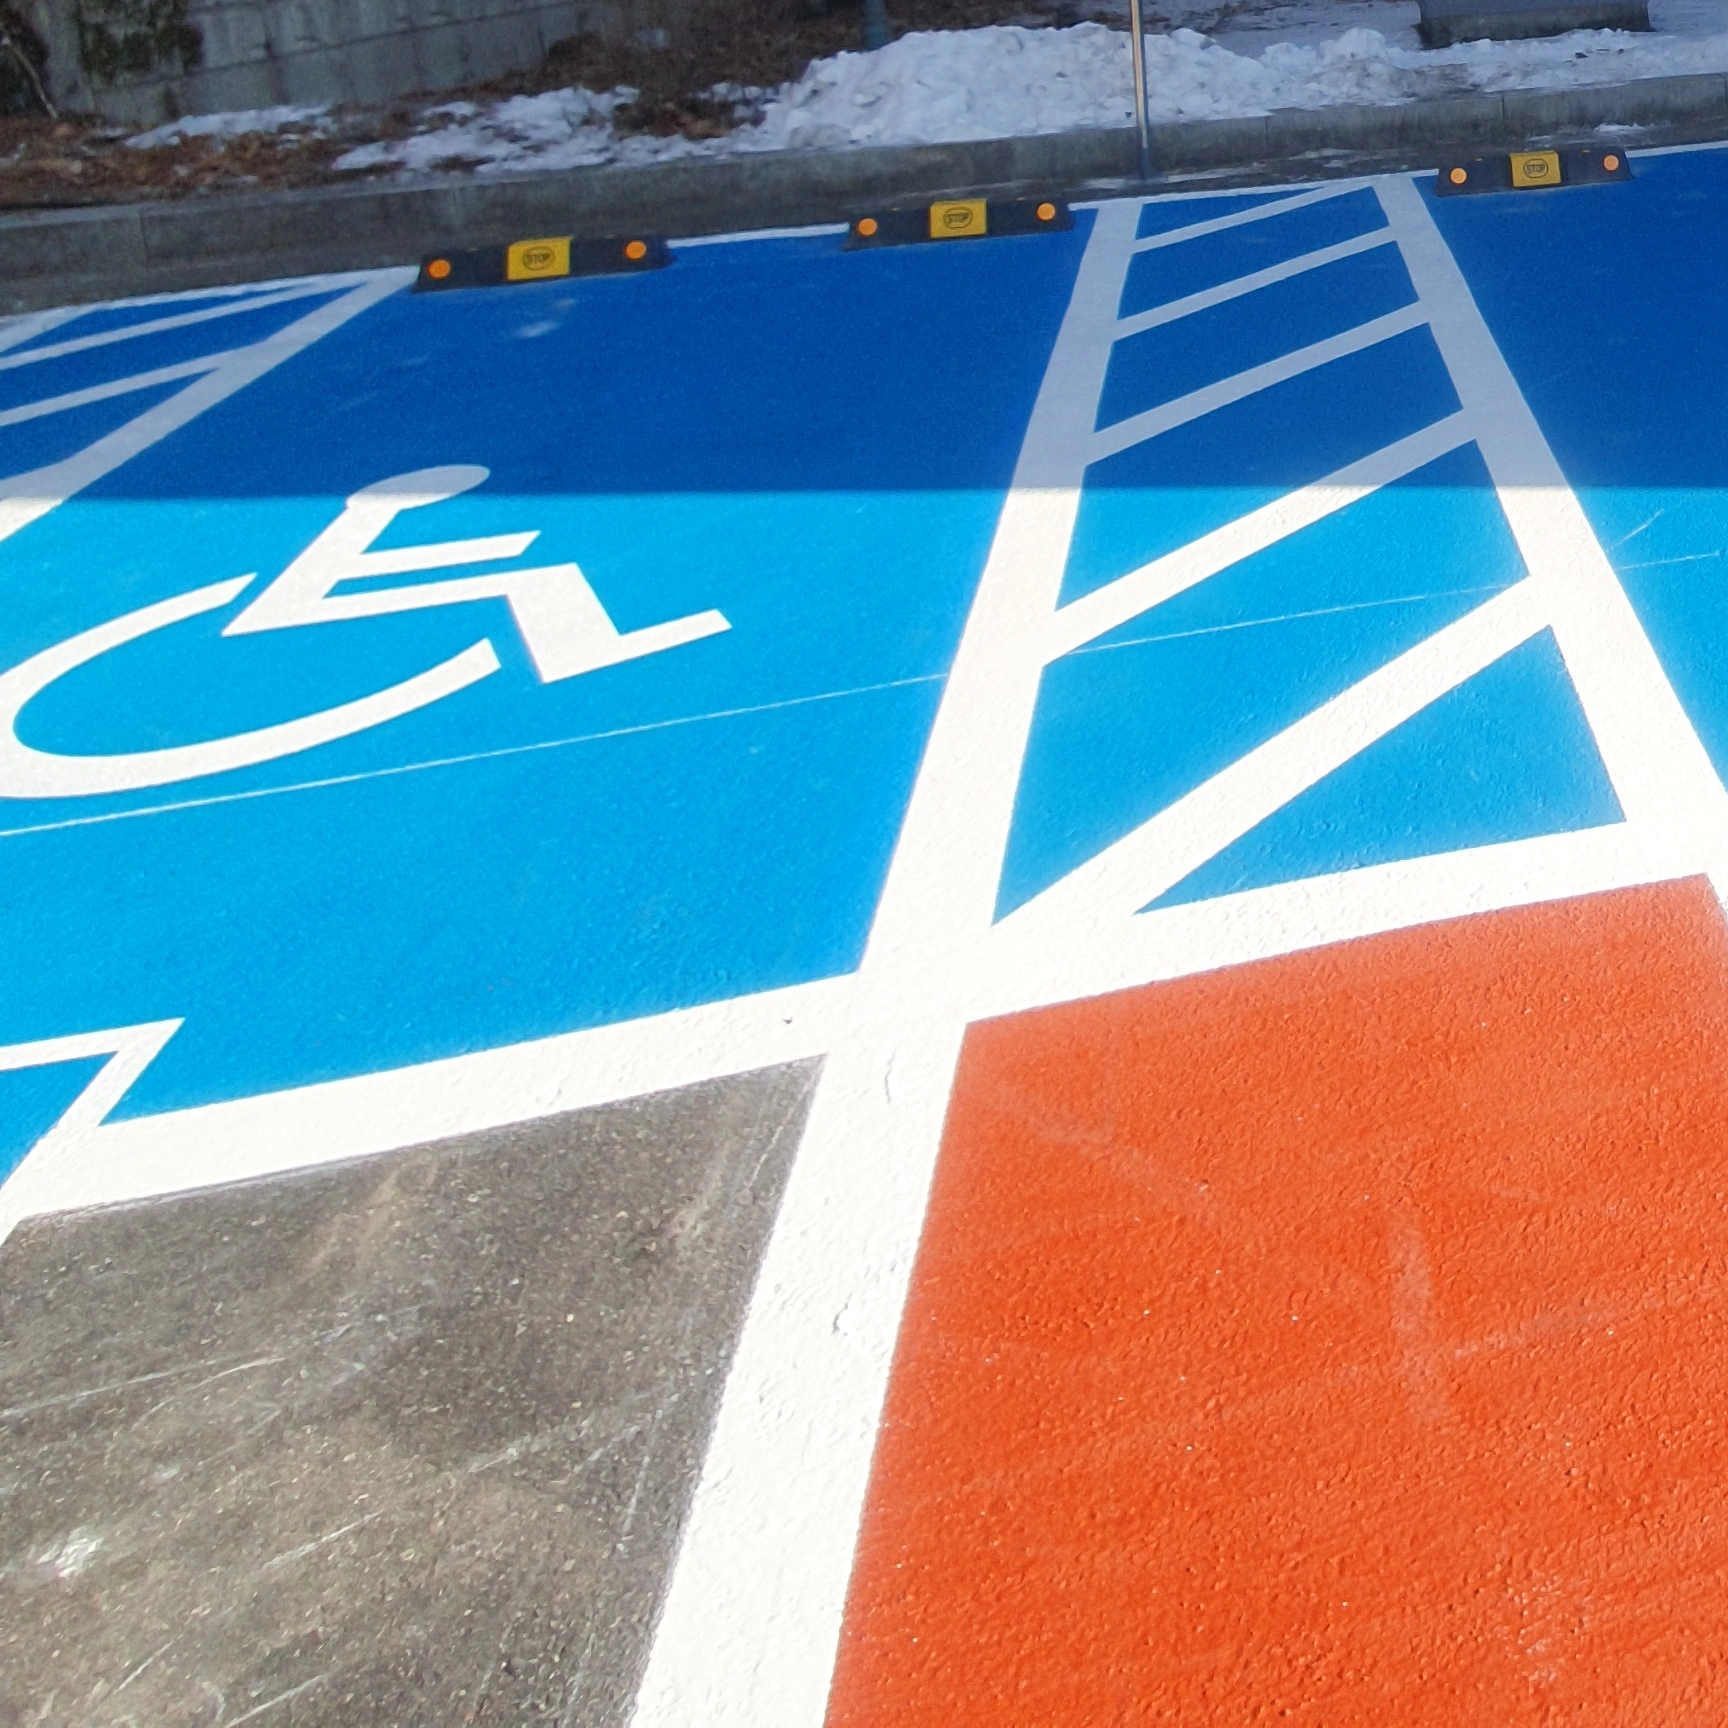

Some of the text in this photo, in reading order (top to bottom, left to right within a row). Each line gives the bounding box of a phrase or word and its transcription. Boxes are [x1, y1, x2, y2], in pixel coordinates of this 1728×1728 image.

[1526, 163, 1545, 175] STOP
[947, 212, 970, 224] STOP
[526, 252, 550, 264] STOP
